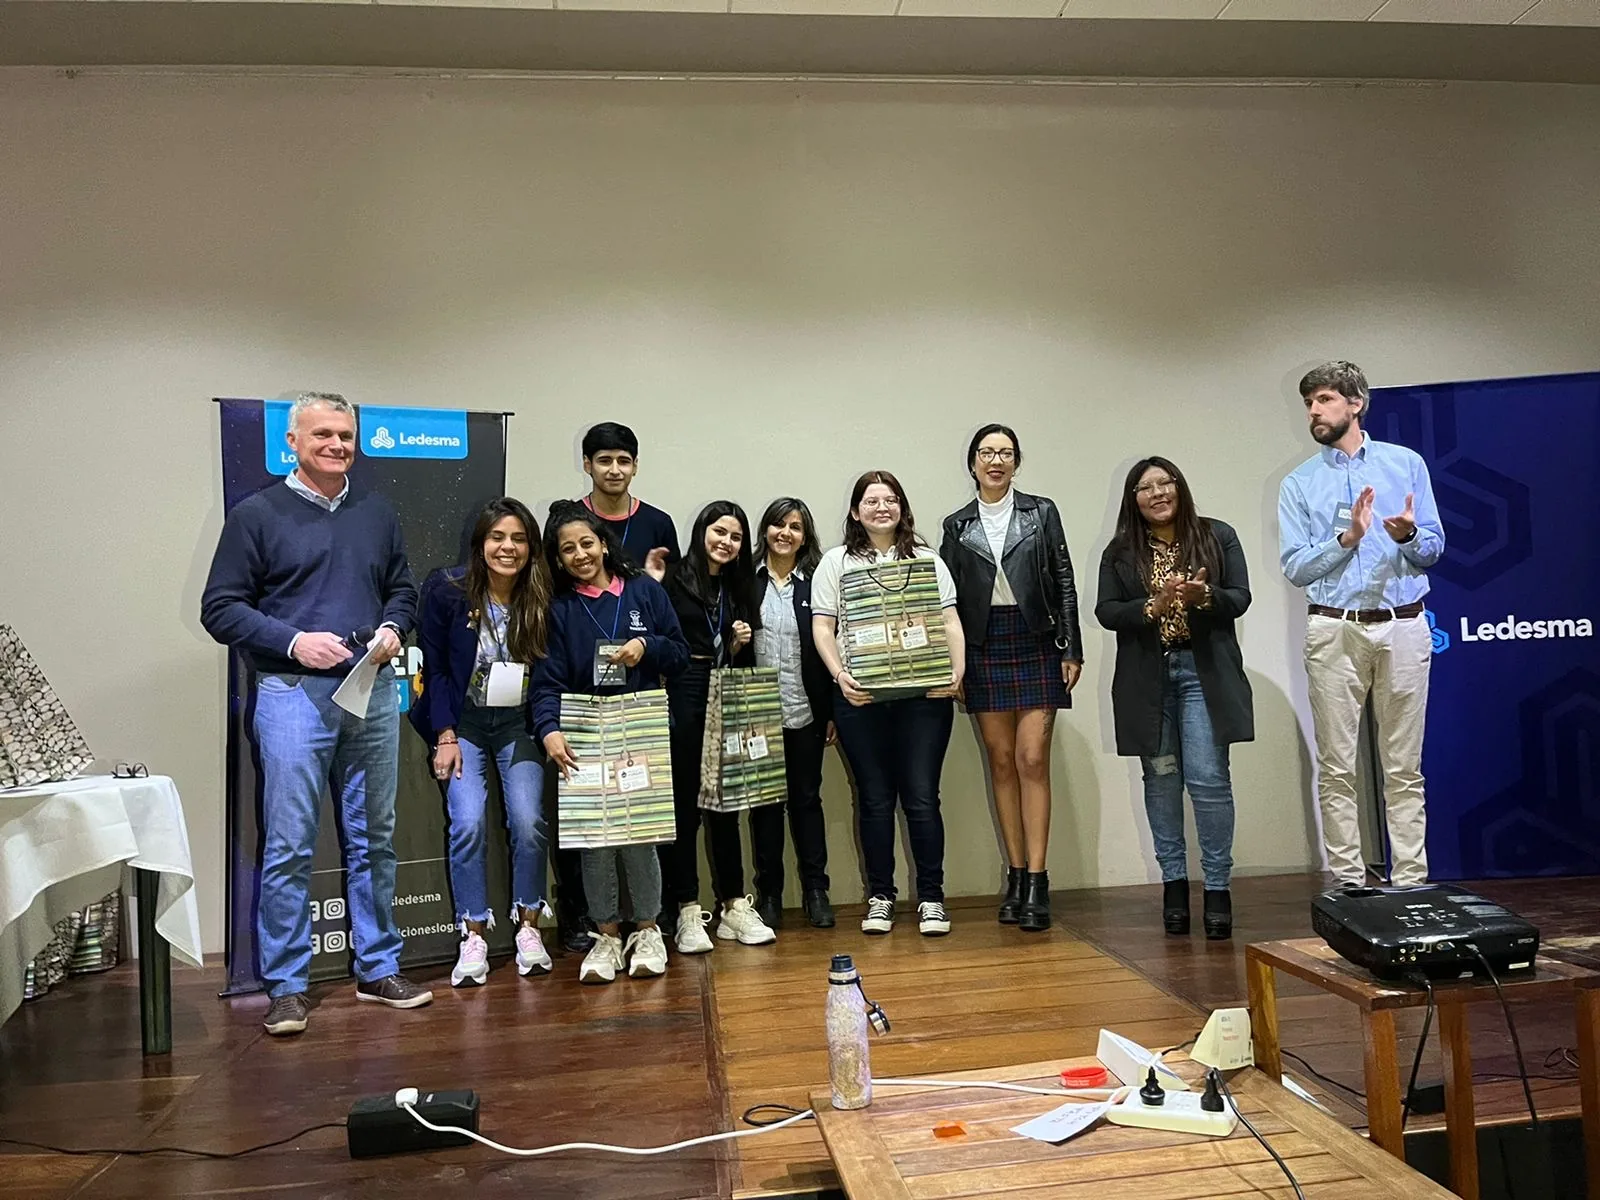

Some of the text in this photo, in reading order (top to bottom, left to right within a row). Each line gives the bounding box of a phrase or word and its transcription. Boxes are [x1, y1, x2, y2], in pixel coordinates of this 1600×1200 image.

[399, 431, 461, 448] Ledesma
[280, 451, 298, 464] Lo
[1460, 614, 1594, 642] Ledesma
[391, 892, 442, 907] sledesma
